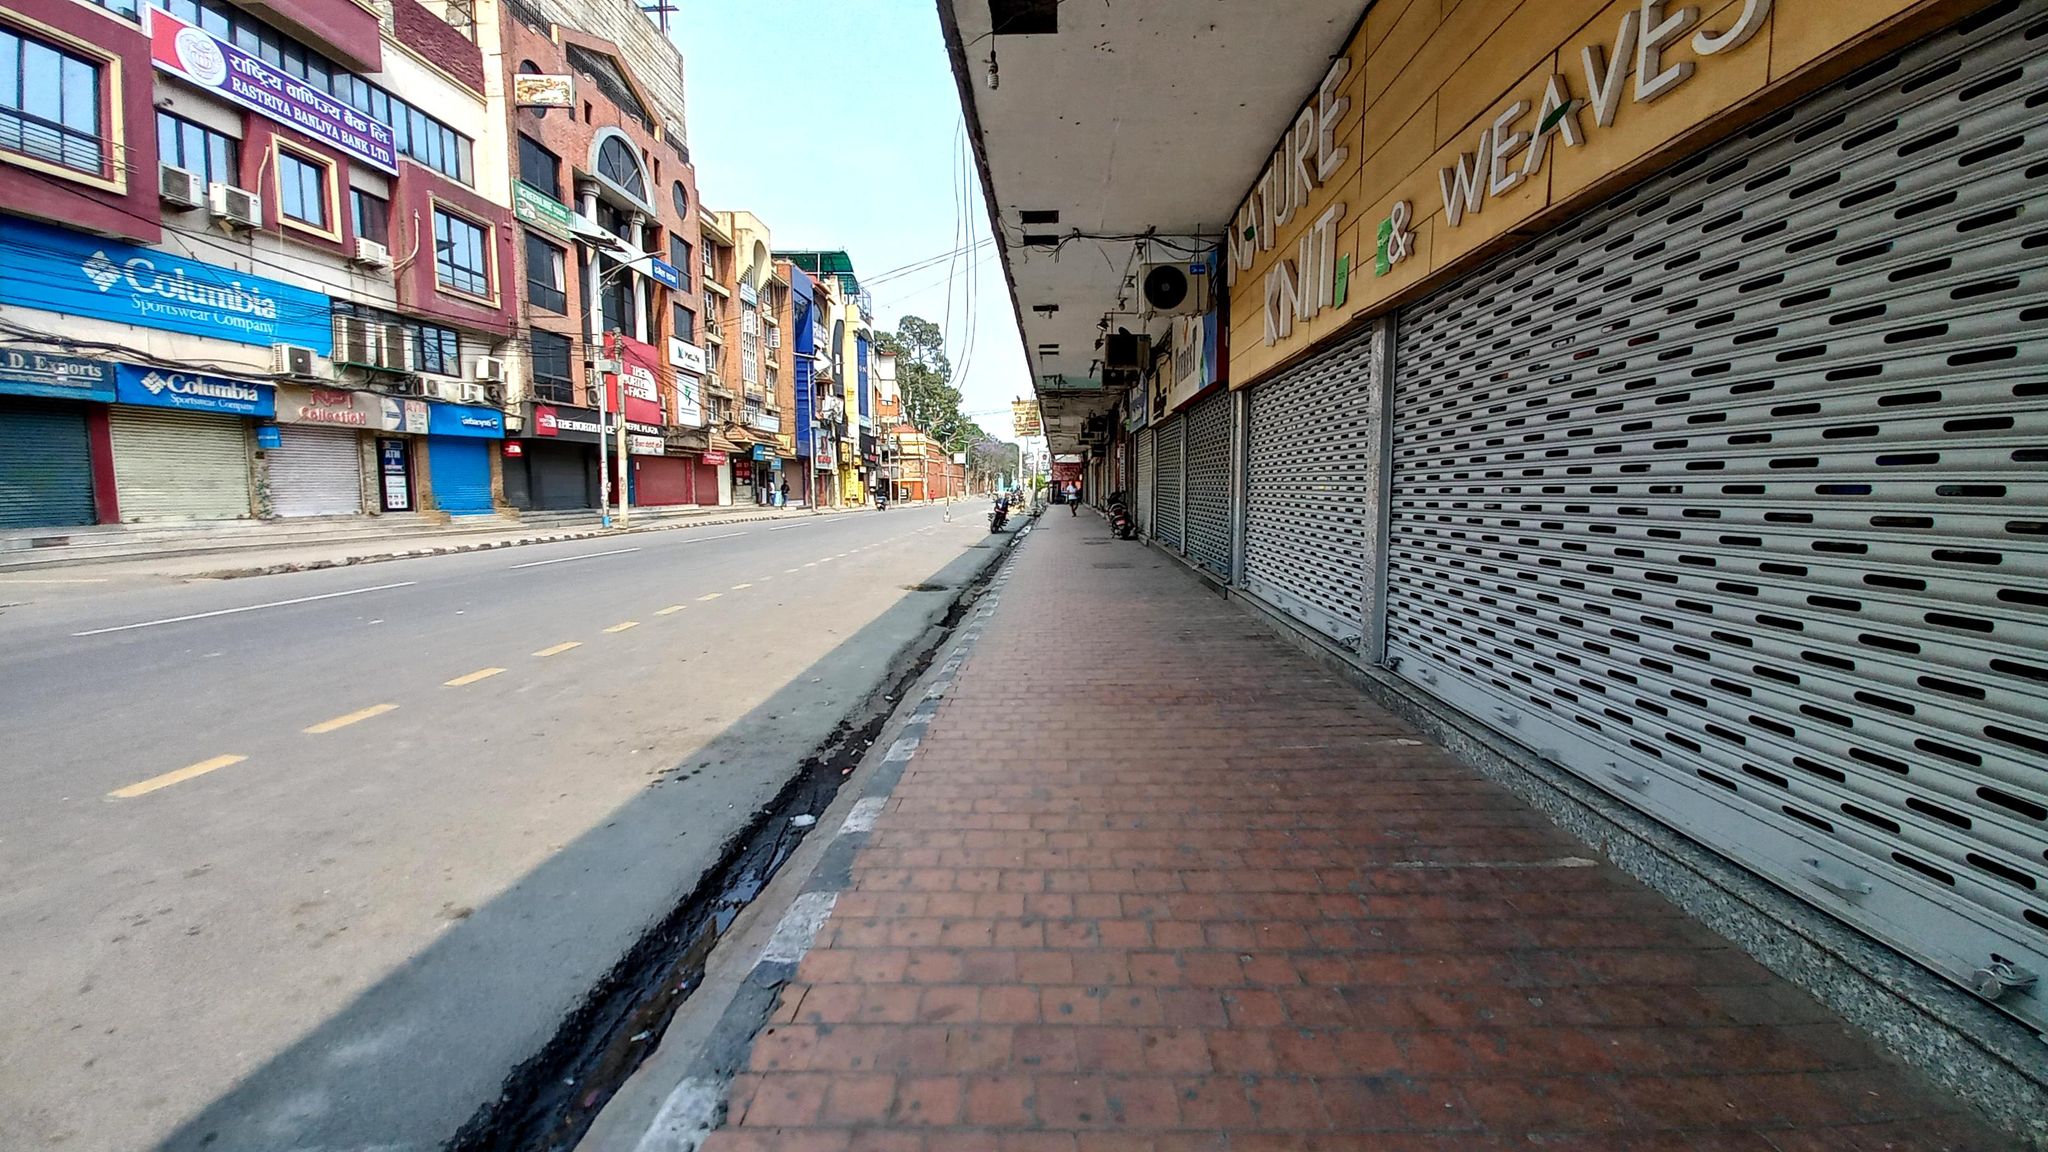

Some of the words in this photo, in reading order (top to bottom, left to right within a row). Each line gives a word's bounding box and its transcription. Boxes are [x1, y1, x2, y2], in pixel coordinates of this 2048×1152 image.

[231, 77, 292, 117] RASTRIYA
[293, 106, 340, 140] BANIJYA
[341, 130, 370, 154] BANK
[370, 144, 393, 165] LTD.
[1227, 57, 1350, 288] NATURE
[124, 257, 277, 319] Columbia
[1263, 202, 1347, 347] KNIT
[1387, 200, 1414, 265] &
[131, 293, 210, 322] Sportswear
[213, 310, 275, 334] Company
[167, 373, 259, 402] Columbia
[623, 373, 645, 389] ORTH
[556, 419, 573, 430] THE
[597, 424, 616, 435] FCE
